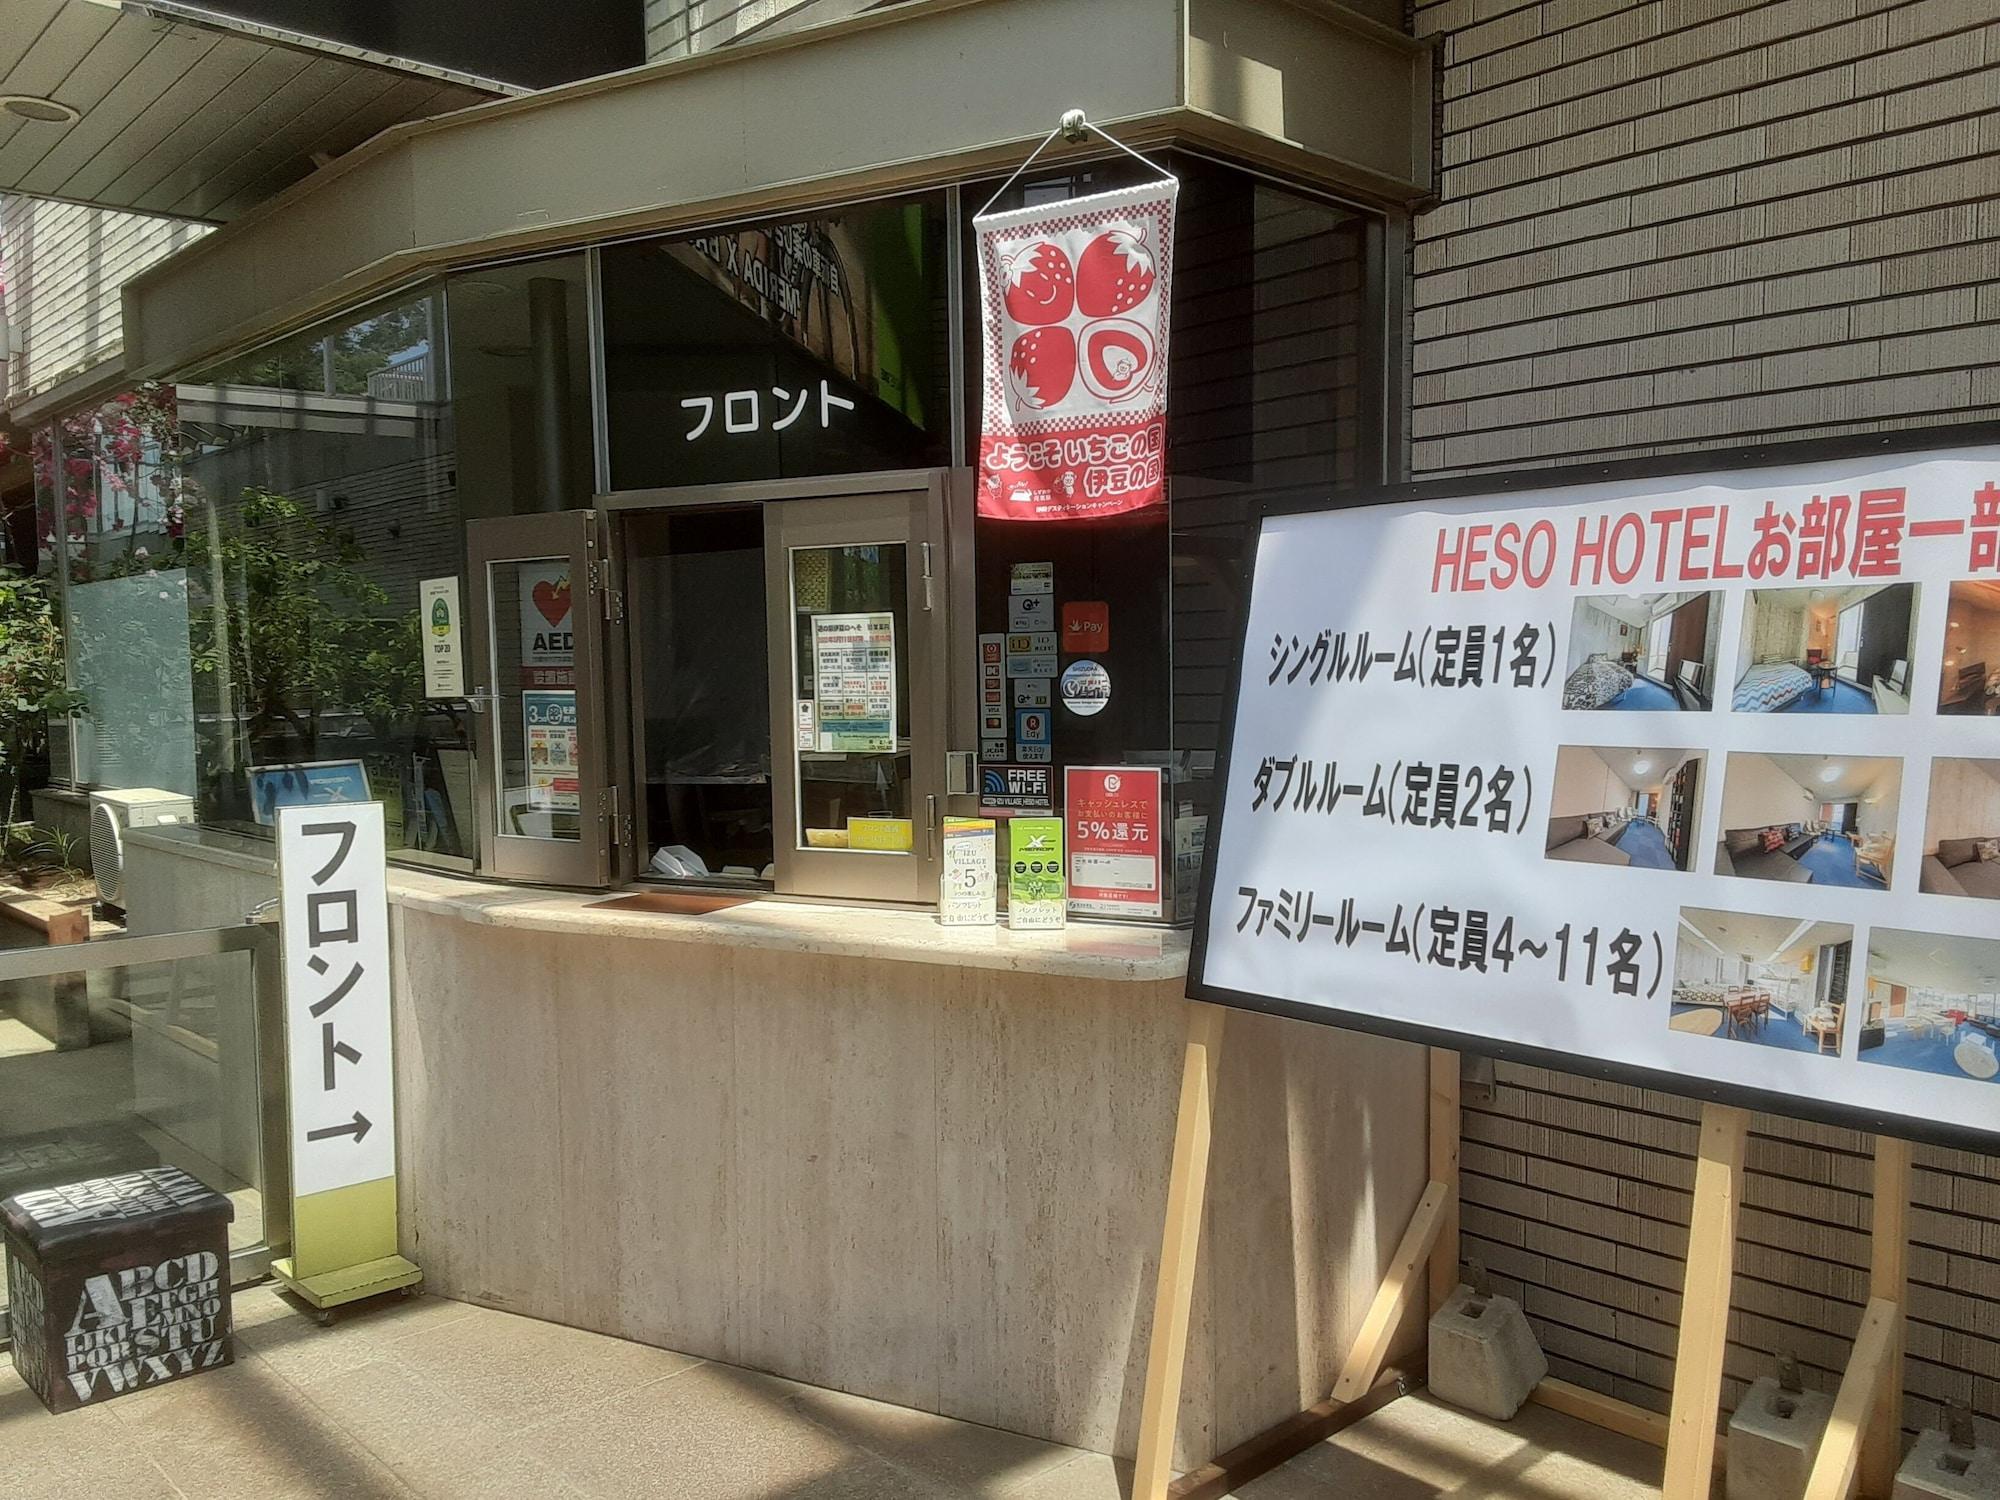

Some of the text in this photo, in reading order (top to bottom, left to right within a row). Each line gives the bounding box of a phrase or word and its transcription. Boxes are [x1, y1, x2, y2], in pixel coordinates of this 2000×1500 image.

[681, 379, 855, 442] フロント
[1083, 455, 1161, 498] 伊豆の国
[1430, 518, 1557, 594] HESO
[1008, 769, 1046, 782] FREE
[1008, 782, 1047, 795] Wi-Fi
[1077, 799, 1148, 809] キャッシュレスで
[1078, 809, 1149, 820] お支払いのお客様に
[1077, 820, 1149, 842] 5%還元
[963, 849, 977, 857] IZU
[964, 868, 976, 888] 5
[301, 821, 365, 1091] フロント
